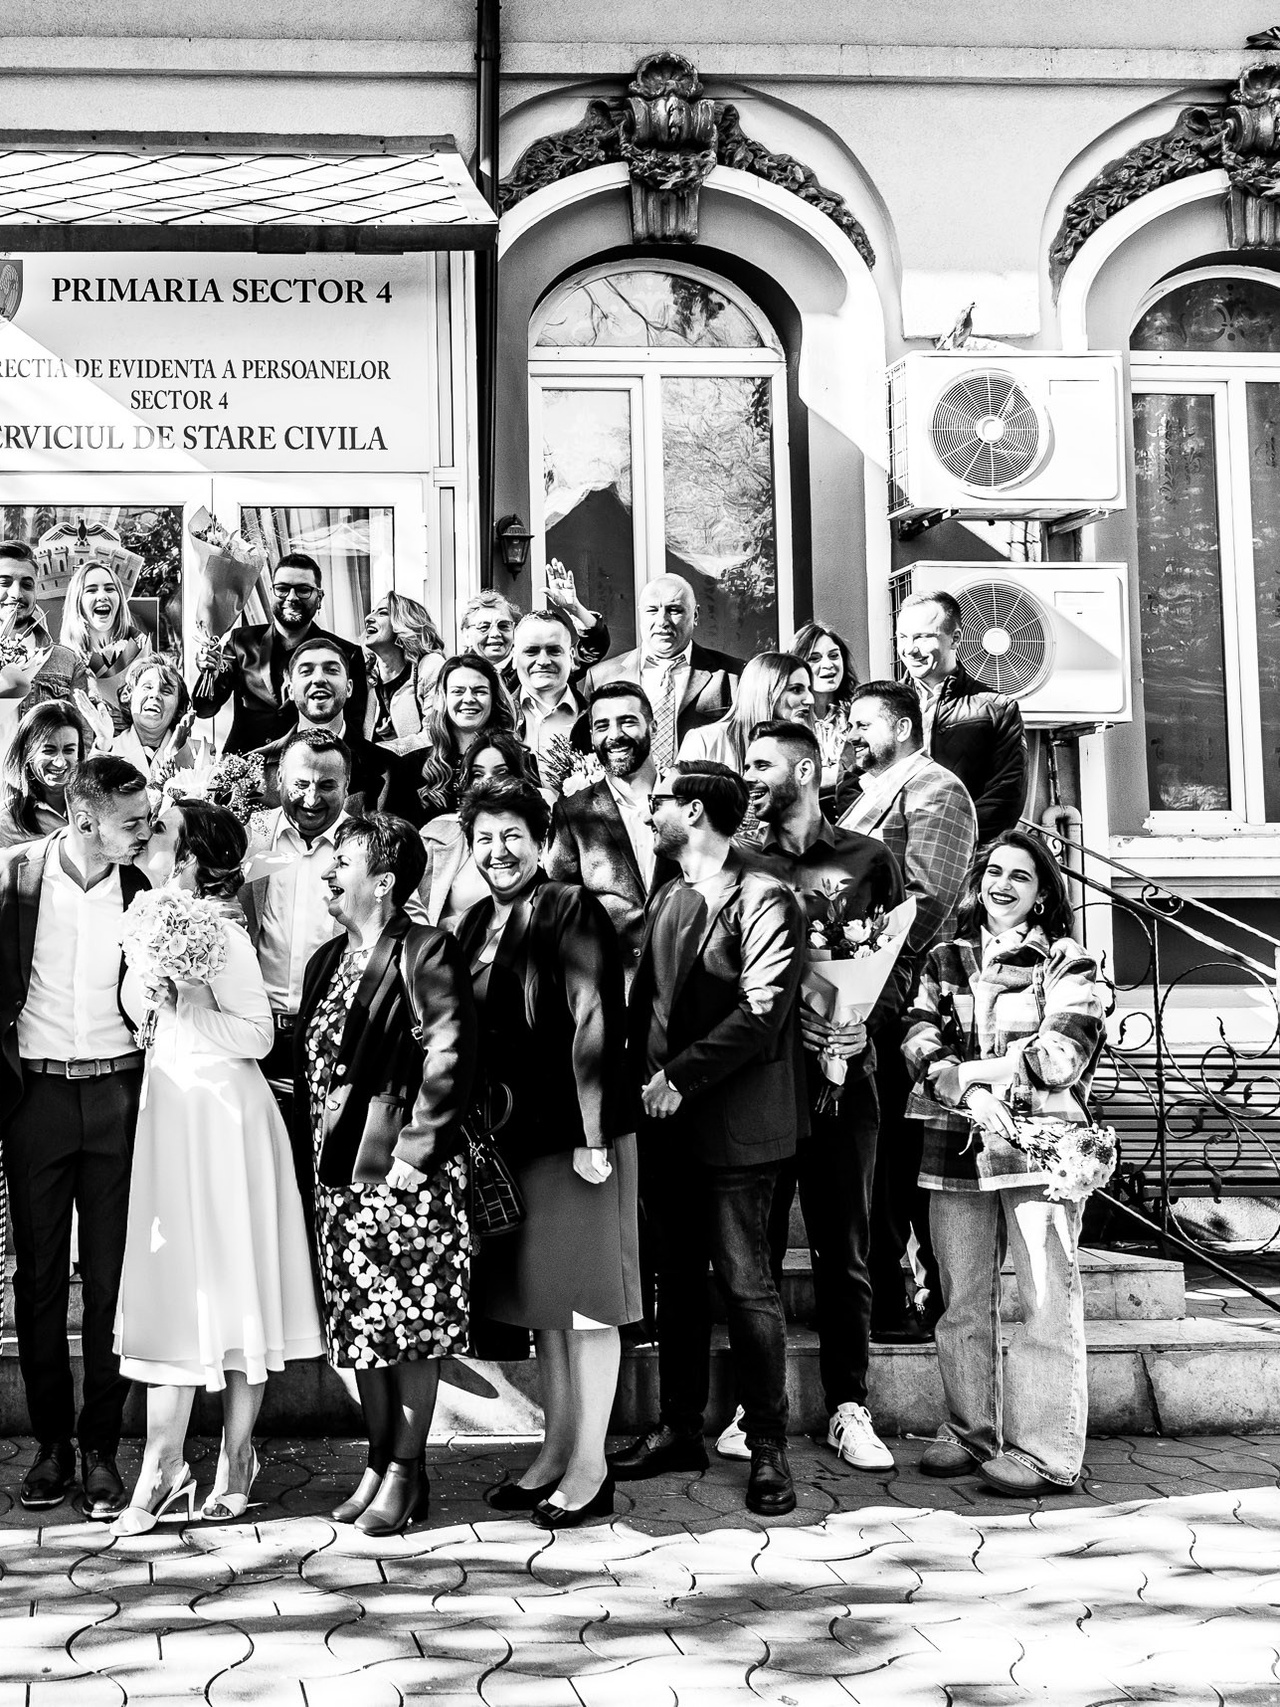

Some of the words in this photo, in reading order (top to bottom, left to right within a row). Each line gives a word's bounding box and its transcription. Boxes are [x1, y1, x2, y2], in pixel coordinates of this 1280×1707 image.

[51, 277, 225, 303] PRIMARIA
[232, 277, 368, 304] SECTOR
[375, 281, 394, 304] 4
[73, 358, 104, 379] DE
[108, 358, 218, 379] EVIDENTA
[221, 358, 238, 379] A
[241, 359, 392, 380] PERSOANELOR
[130, 389, 214, 411] SECTOR
[218, 391, 230, 411] 4
[132, 424, 176, 450] DE
[182, 424, 278, 451] STARE
[283, 425, 389, 451] CIVILA
